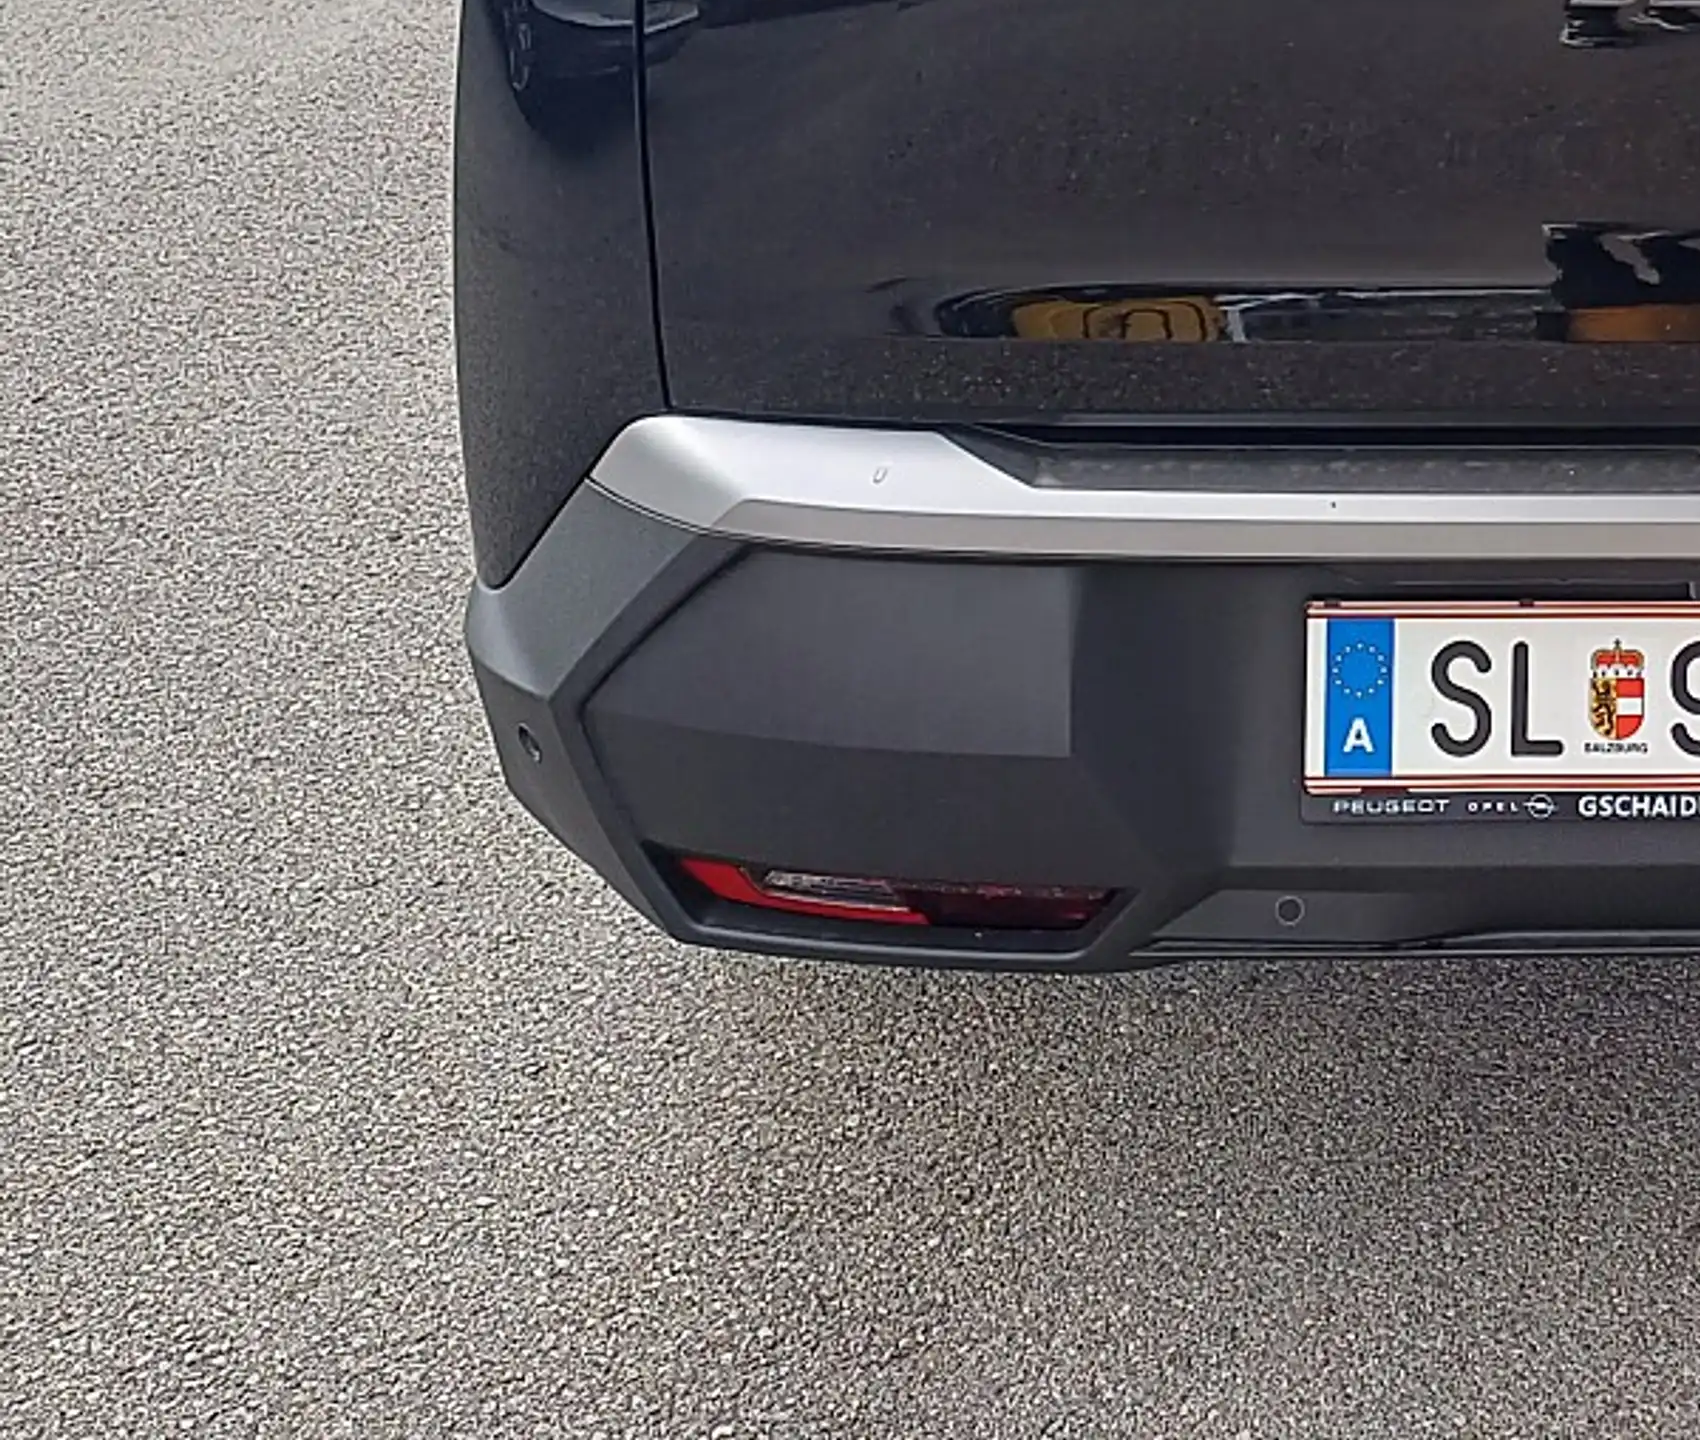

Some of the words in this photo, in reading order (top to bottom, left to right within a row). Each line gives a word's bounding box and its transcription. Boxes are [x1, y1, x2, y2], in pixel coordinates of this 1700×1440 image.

[1431, 639, 1564, 758] SL
[1342, 717, 1375, 754] A
[1584, 742, 1648, 755] SALZBURG
[1332, 798, 1450, 814] PEUGEOT
[1467, 800, 1520, 813] OPEL
